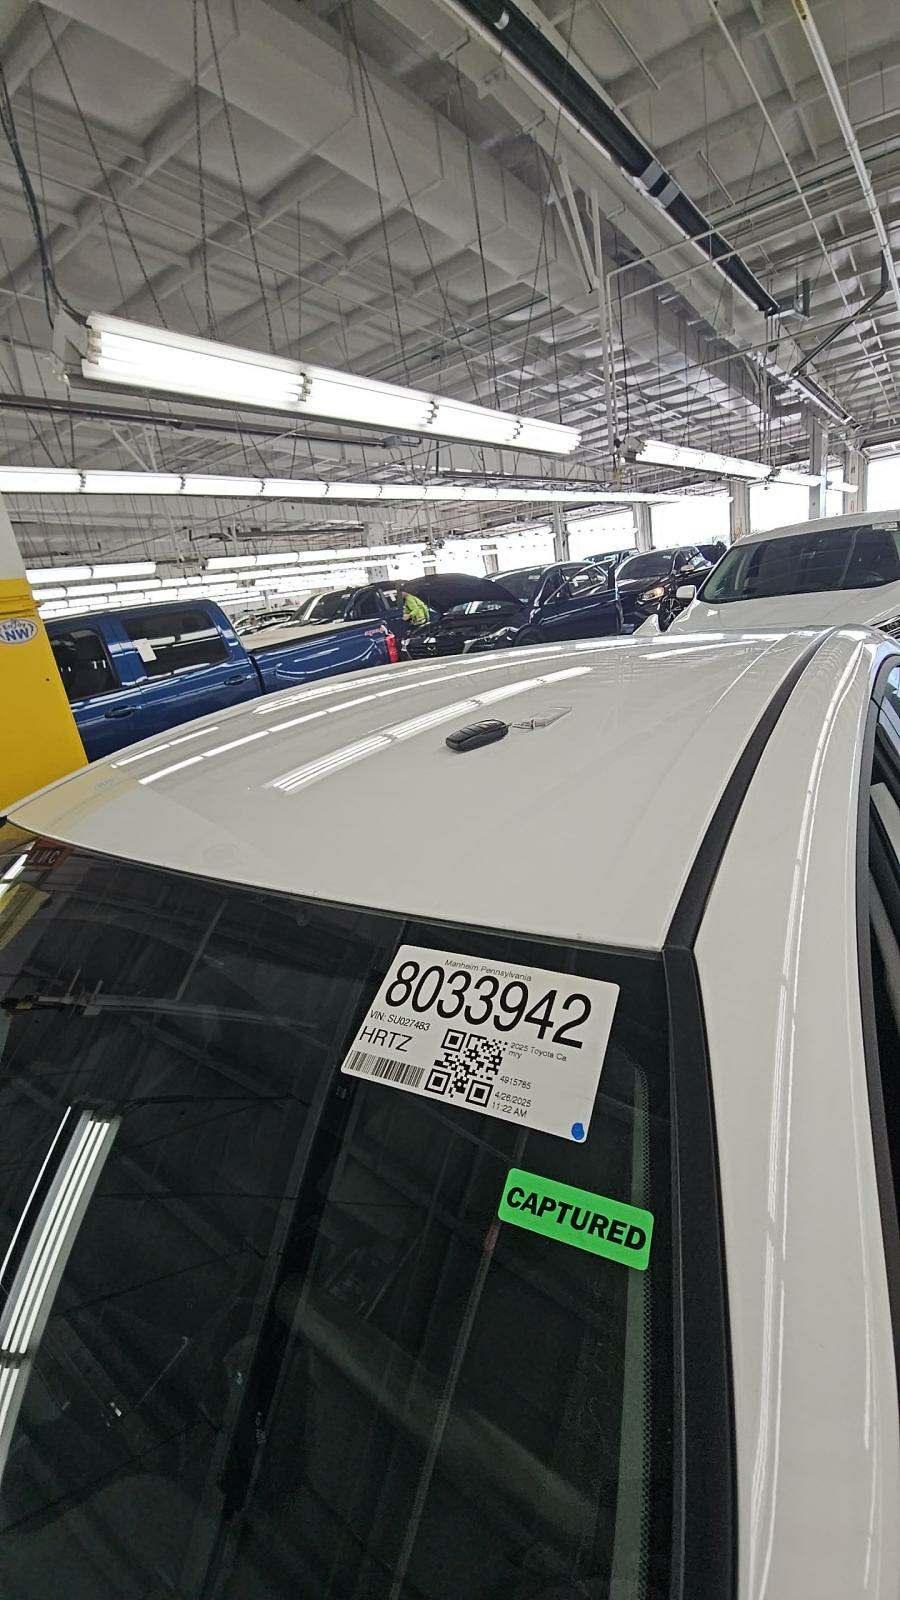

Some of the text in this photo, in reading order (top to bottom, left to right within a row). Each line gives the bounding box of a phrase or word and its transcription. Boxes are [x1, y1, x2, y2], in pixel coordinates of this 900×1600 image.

[4, 627, 29, 642] NW
[445, 960, 532, 982] Manheim Pennsylvania
[385, 960, 592, 1049] 8033942
[370, 1009, 431, 1031] VIN: SU027483
[359, 1025, 413, 1052] HRTZ
[508, 1050, 523, 1060] mry
[510, 1042, 567, 1062] 2025 Toyota Ca
[492, 1101, 528, 1118] 11:22 AM
[506, 1186, 647, 1251] CAPTURED
